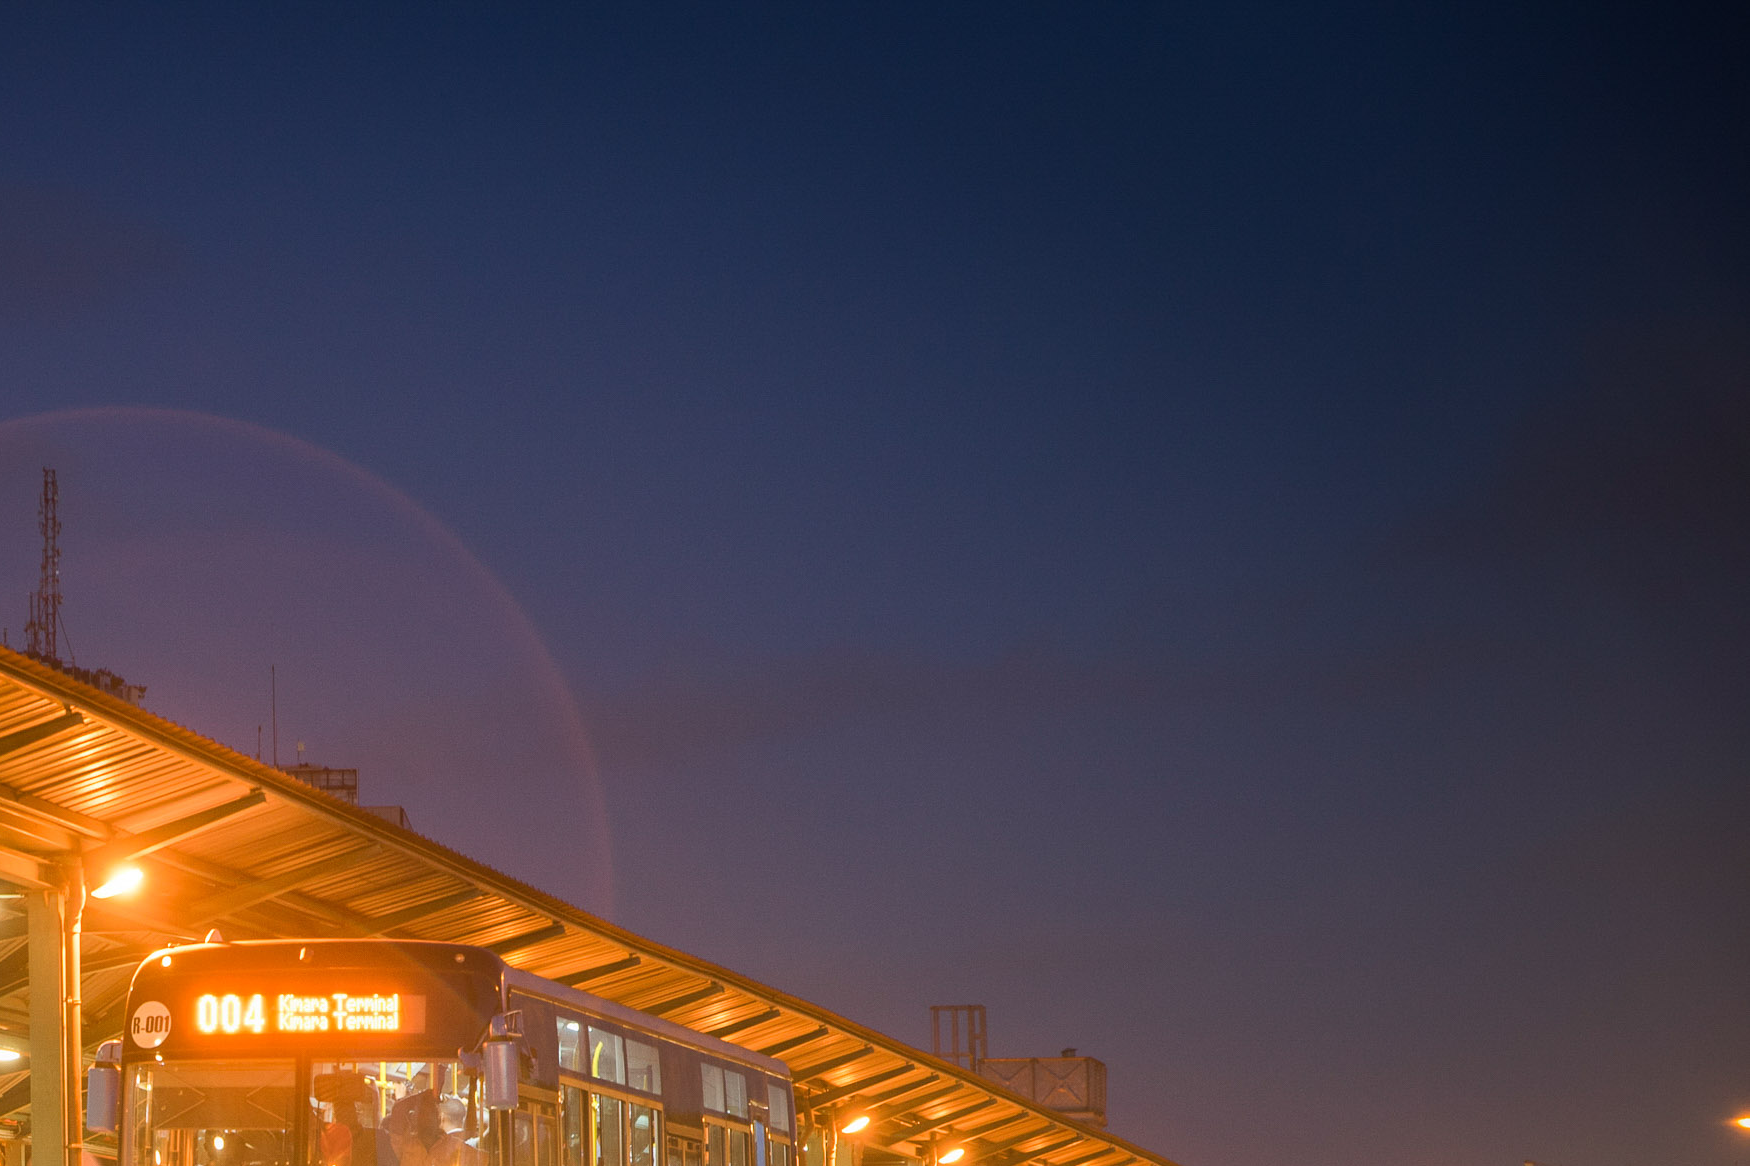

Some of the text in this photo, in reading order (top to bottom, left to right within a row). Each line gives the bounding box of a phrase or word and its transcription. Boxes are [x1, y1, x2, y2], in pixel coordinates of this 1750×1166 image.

[198, 994, 265, 1034] 004
[331, 993, 399, 1013] Terminal
[331, 1011, 399, 1031] Terminal
[132, 1015, 171, 1035] R-001
